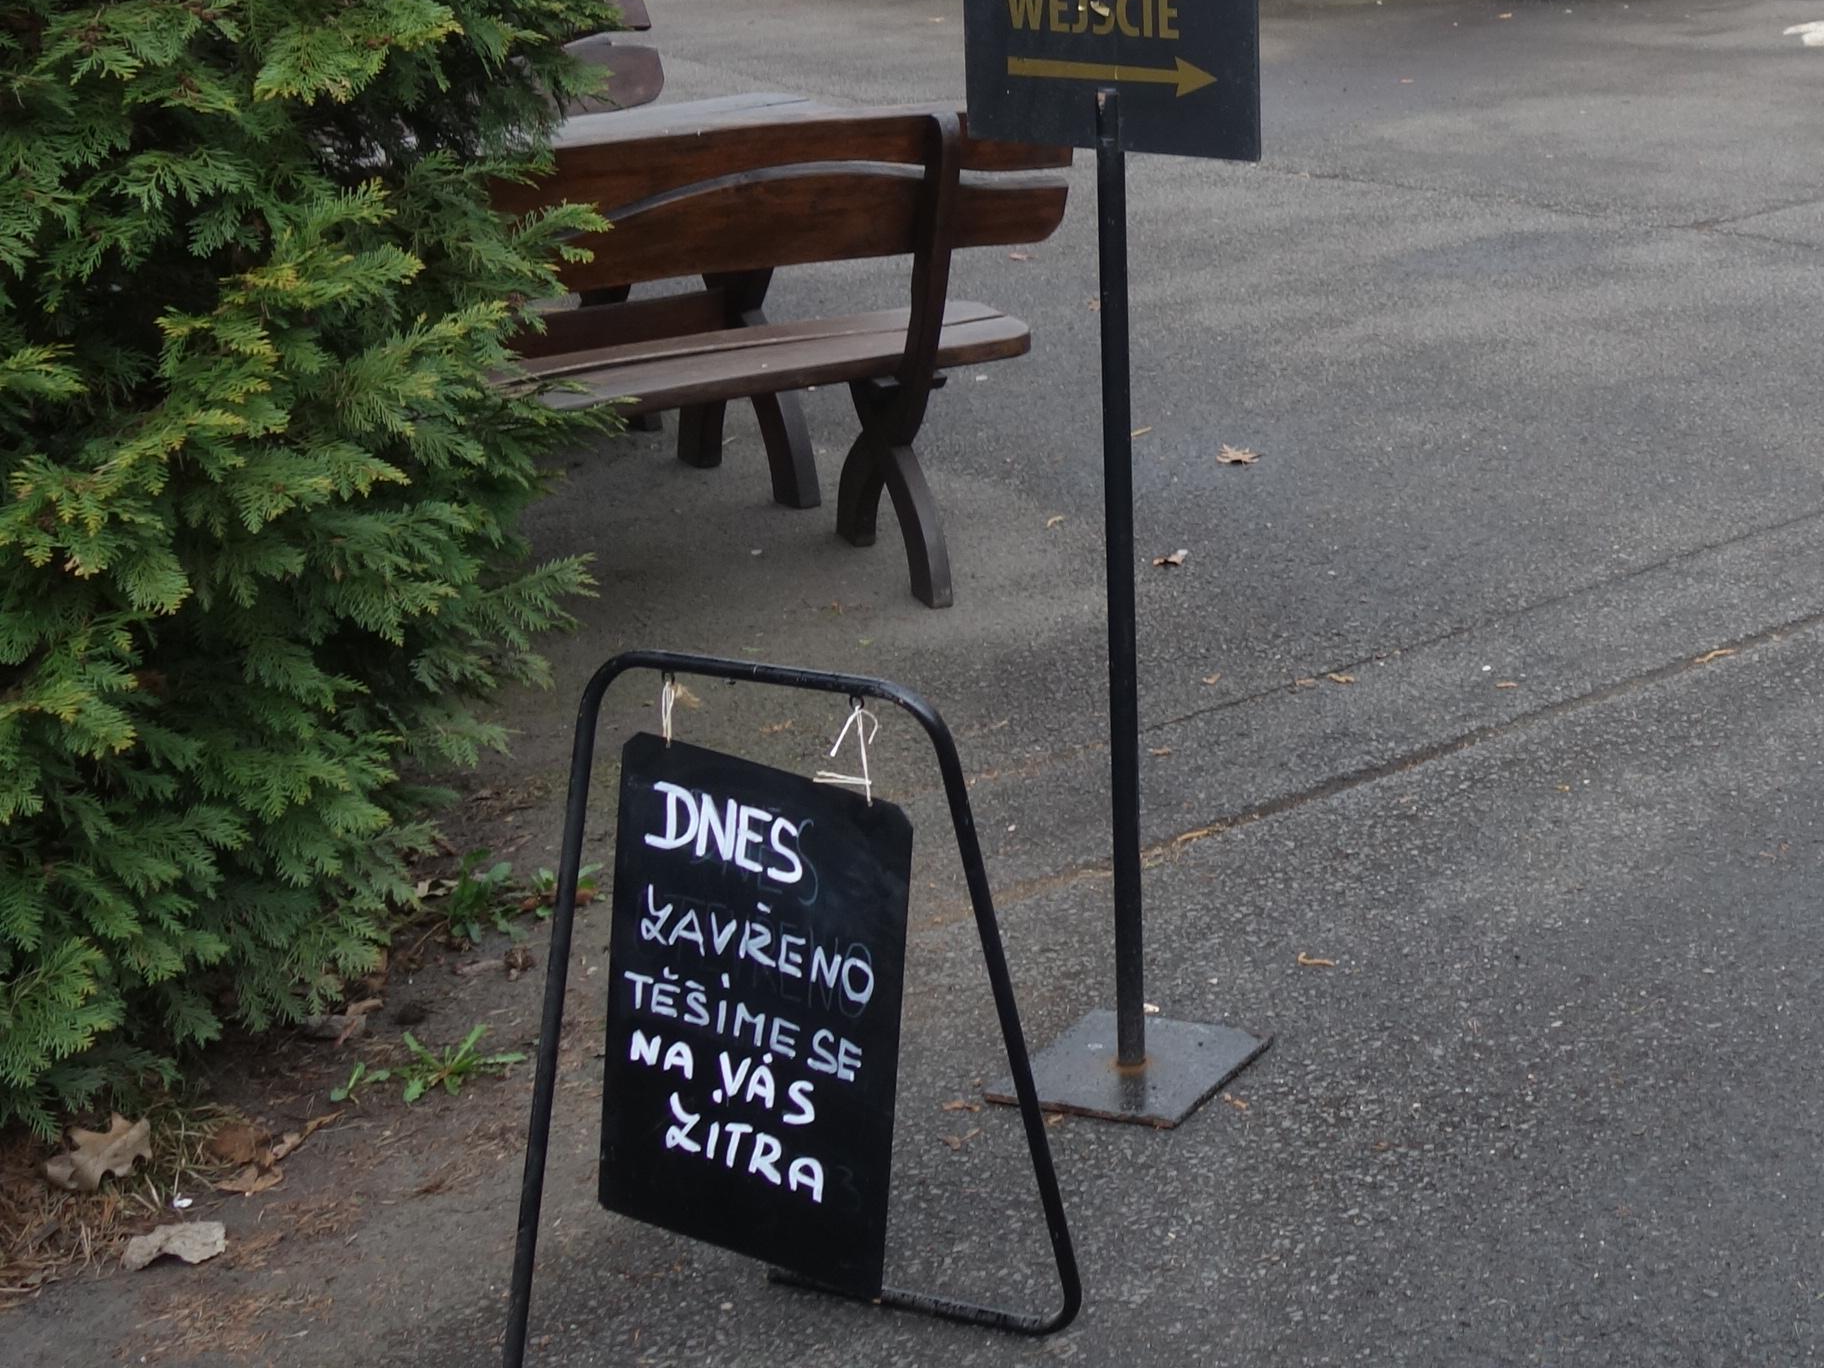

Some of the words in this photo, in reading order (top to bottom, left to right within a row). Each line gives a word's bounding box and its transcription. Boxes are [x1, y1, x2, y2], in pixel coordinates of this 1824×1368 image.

[643, 780, 803, 885] DNES
[630, 1030, 694, 1080] NA
[718, 1050, 816, 1125] VÁS
